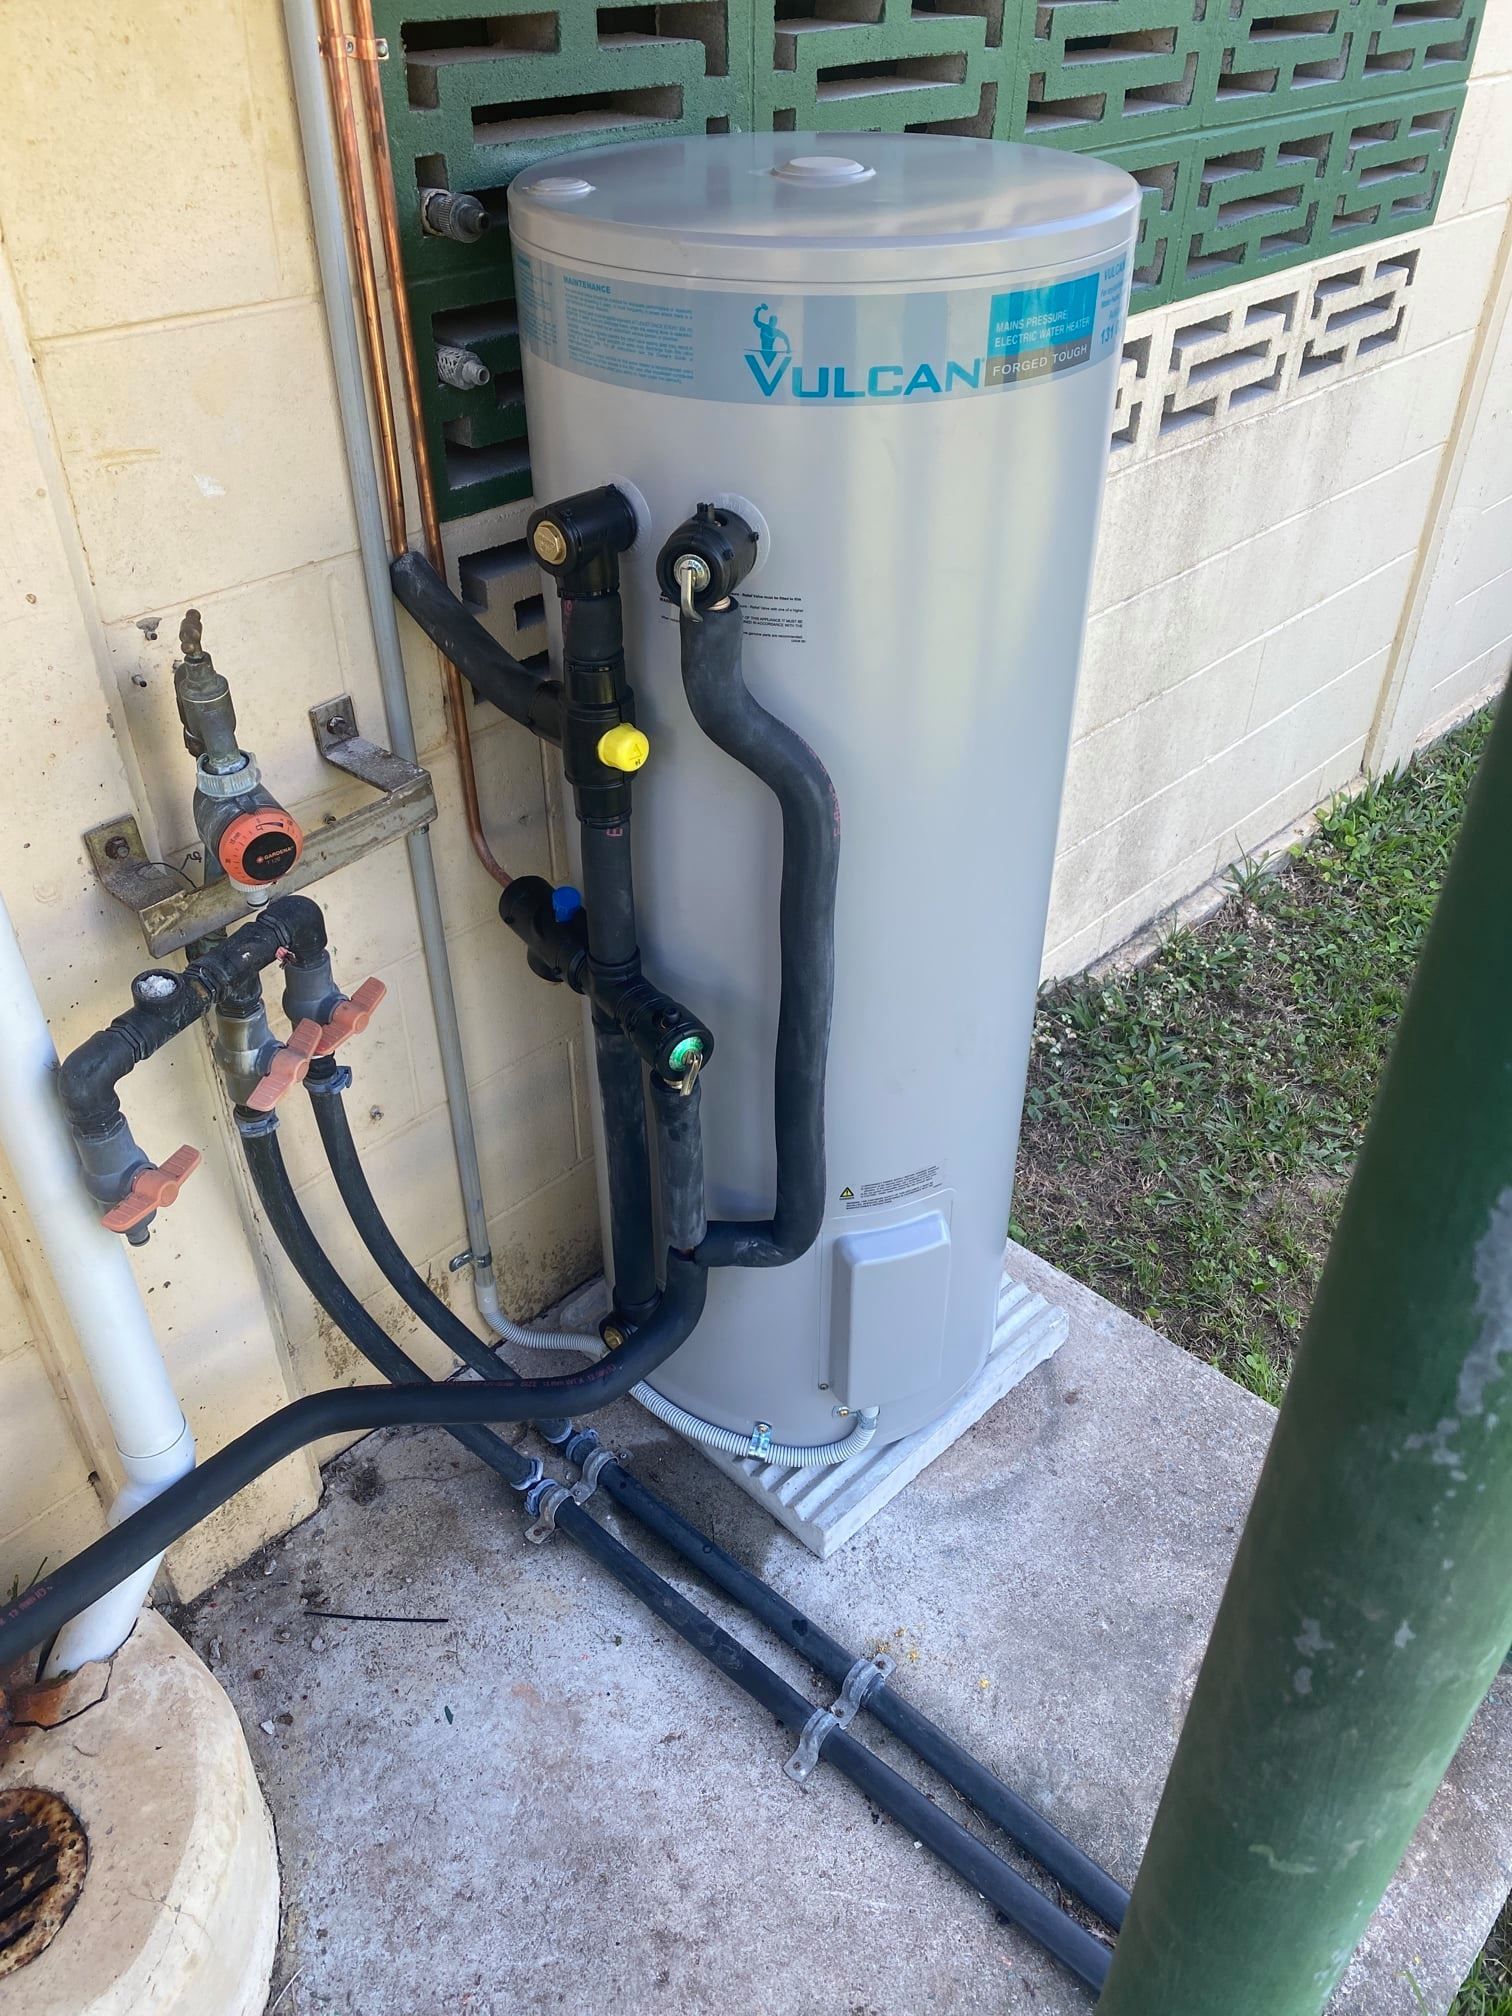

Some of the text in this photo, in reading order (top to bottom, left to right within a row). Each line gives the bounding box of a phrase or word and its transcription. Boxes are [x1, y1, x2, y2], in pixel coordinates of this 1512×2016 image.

[563, 275, 611, 294] MAINTENANCE
[995, 317, 1090, 347] ELECTRIC WATER HEATER
[996, 310, 1067, 333] MAINS PRESSURE
[993, 344, 1087, 377] FORGED TOUGH
[744, 354, 980, 398] VULCAN
[264, 846, 291, 860] GARDENA
